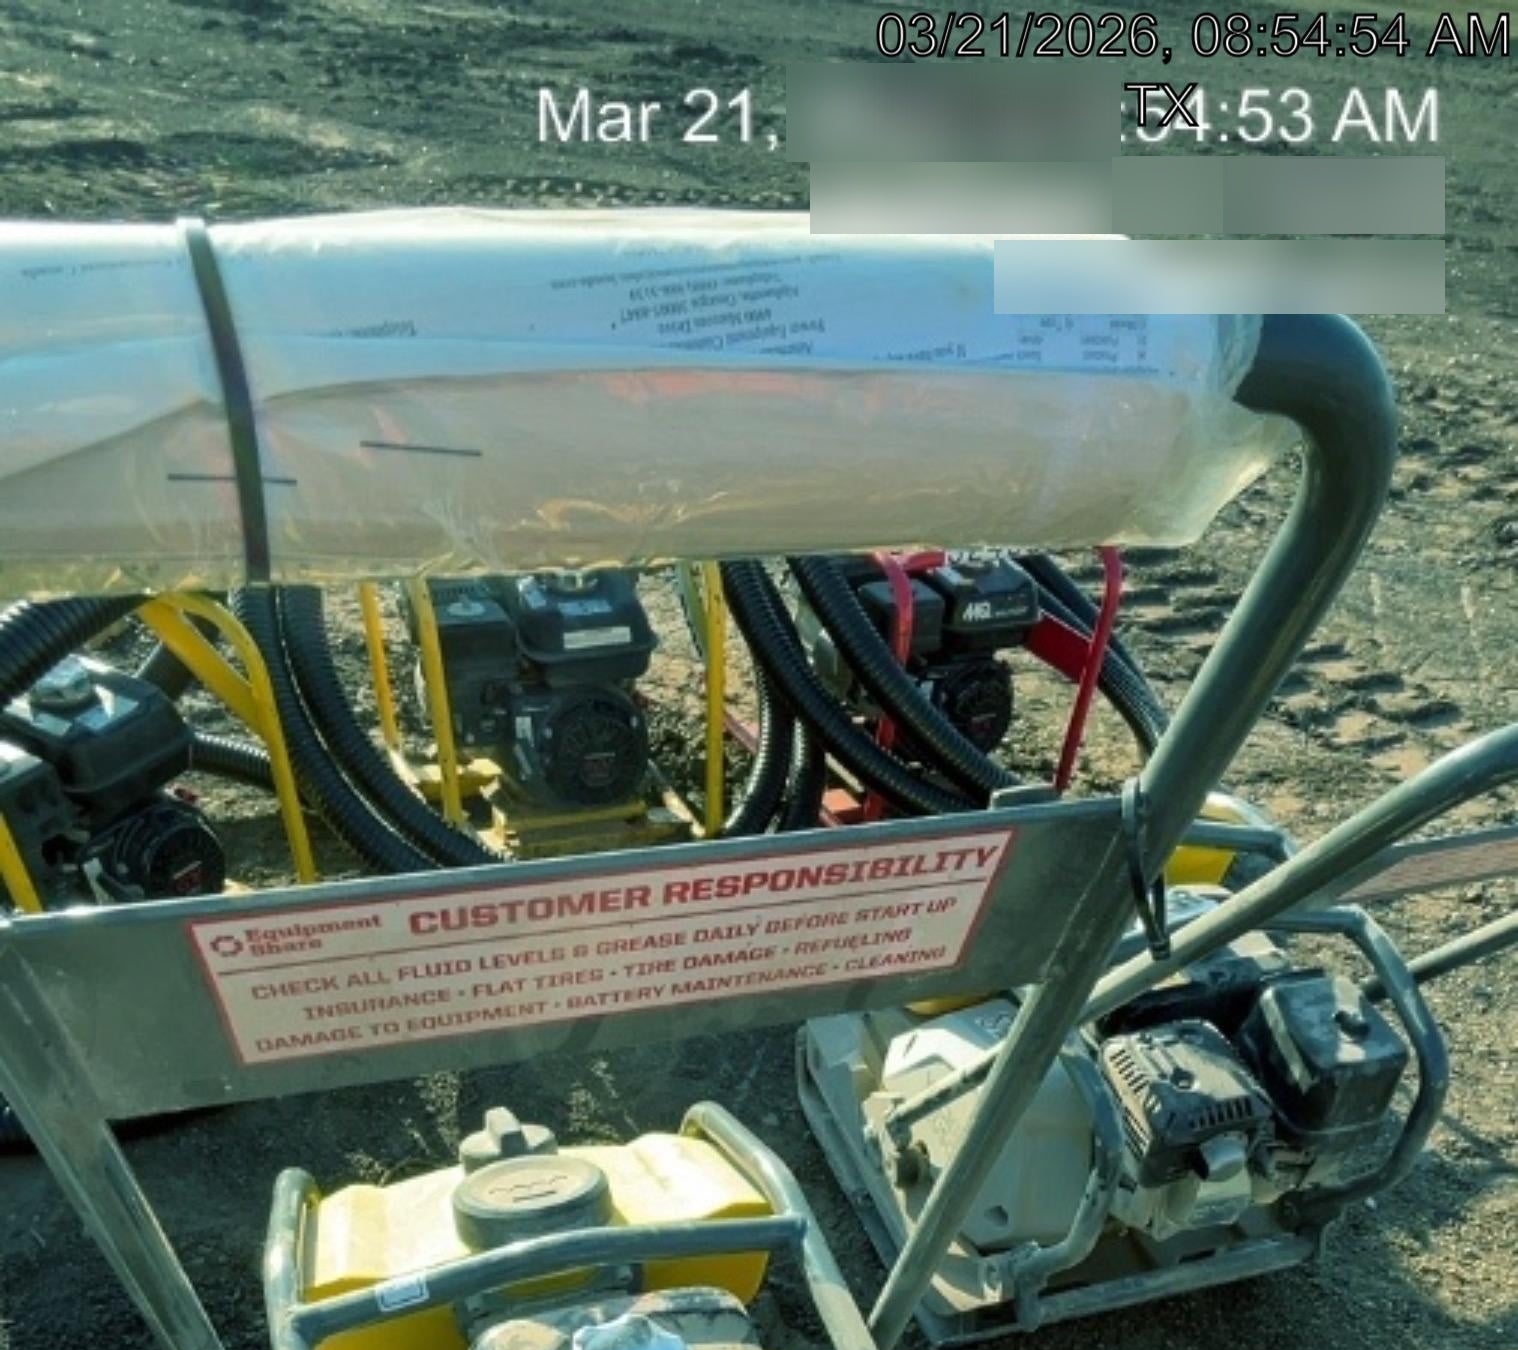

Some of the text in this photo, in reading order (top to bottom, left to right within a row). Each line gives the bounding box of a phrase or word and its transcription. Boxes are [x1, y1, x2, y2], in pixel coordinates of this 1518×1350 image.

[245, 914, 383, 942] Equipment
[409, 845, 999, 935] CUSTOMER RESPONSIBILITY
[247, 938, 323, 957] Share
[251, 976, 340, 1000] CHECK
[347, 969, 390, 988] ALL
[398, 959, 472, 981] FLUID
[479, 943, 565, 970] LEVELS
[596, 929, 687, 955] GREASE
[693, 922, 760, 943] DAILY
[765, 910, 847, 934] BEFORE
[854, 902, 923, 925] START
[926, 896, 957, 913] UP
[303, 927, 913, 1020] INSURANCE FLAT TIRES TIRE DAMAGE REFUELING
[255, 946, 947, 1052] DAMAGE TO EQUIPMENT BATTERY MAINTENANCE CLEANING
